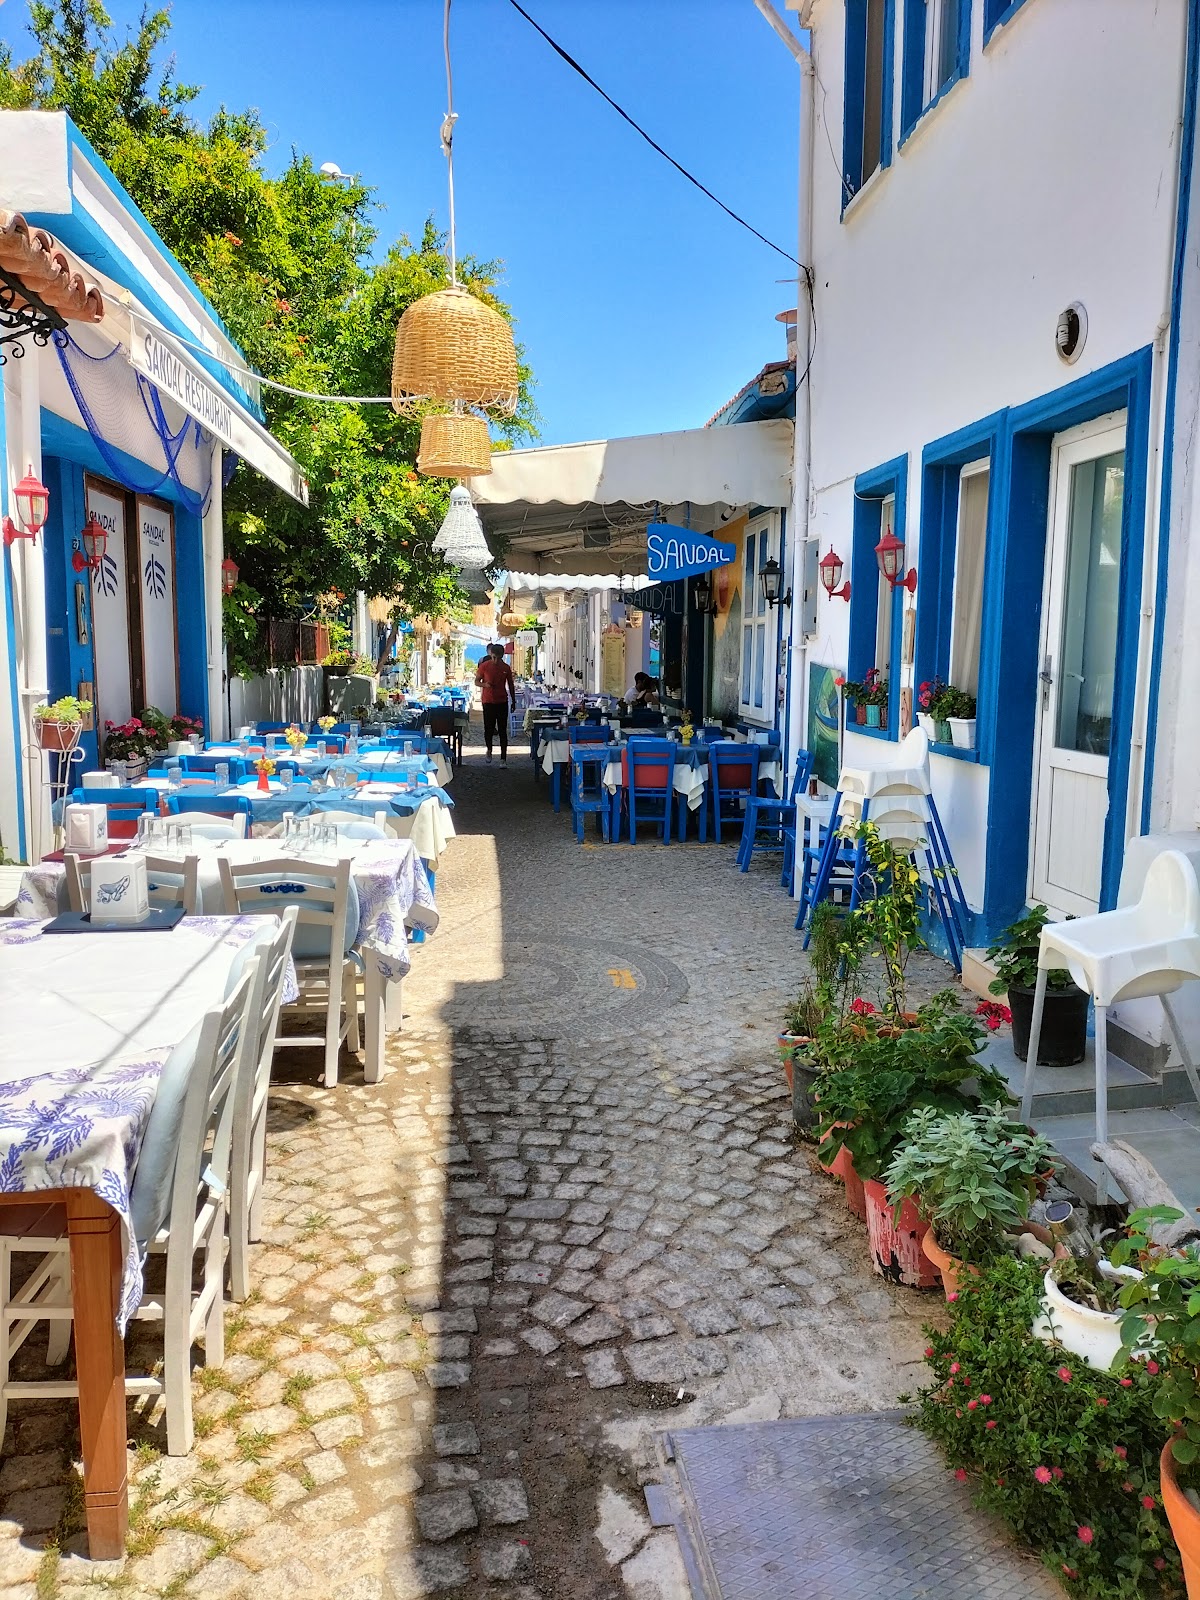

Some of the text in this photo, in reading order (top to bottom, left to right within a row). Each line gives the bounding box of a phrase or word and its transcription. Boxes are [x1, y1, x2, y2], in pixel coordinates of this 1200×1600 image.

[144, 333, 233, 440] SANDAL RESTAURANT
[143, 522, 165, 543] SANDAL
[647, 534, 730, 573] SANDAL
[625, 583, 682, 615] SANDAL
